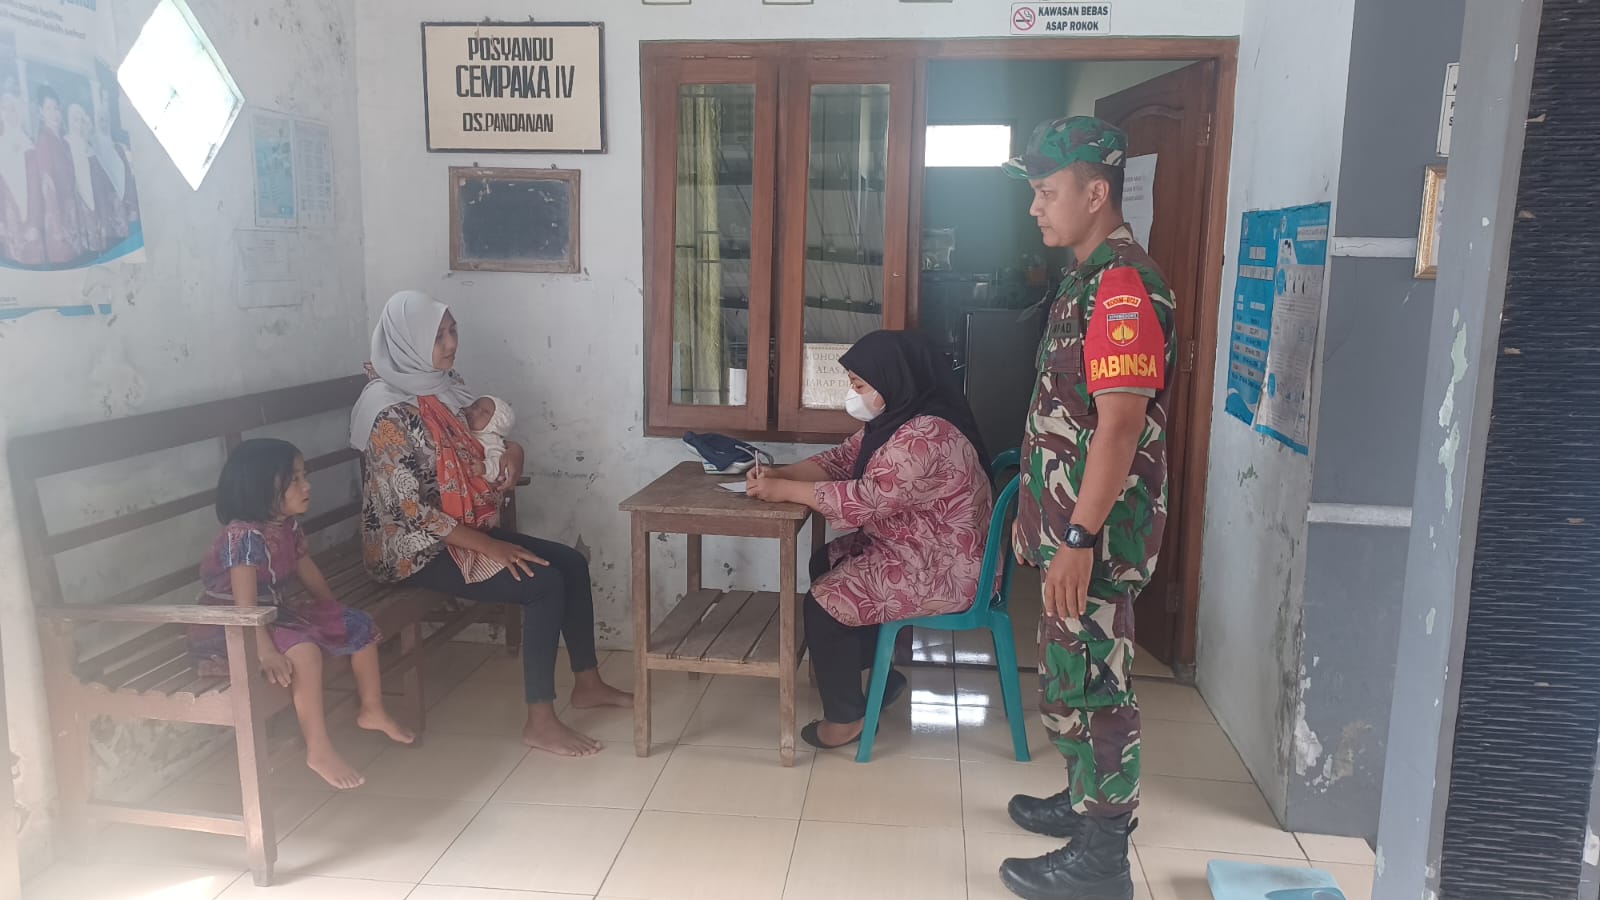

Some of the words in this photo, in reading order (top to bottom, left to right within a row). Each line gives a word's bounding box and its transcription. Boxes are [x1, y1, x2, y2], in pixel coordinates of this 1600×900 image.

[1038, 6, 1079, 16] KAWASAN
[1081, 6, 1108, 16] BEBAS
[1045, 21, 1068, 31] ASAP
[1069, 21, 1099, 31] ROKOK
[467, 37, 554, 61] POSYANDU
[455, 65, 551, 98] CEMPAKA
[555, 65, 575, 98] IV
[1090, 353, 1158, 381] BABINSA
